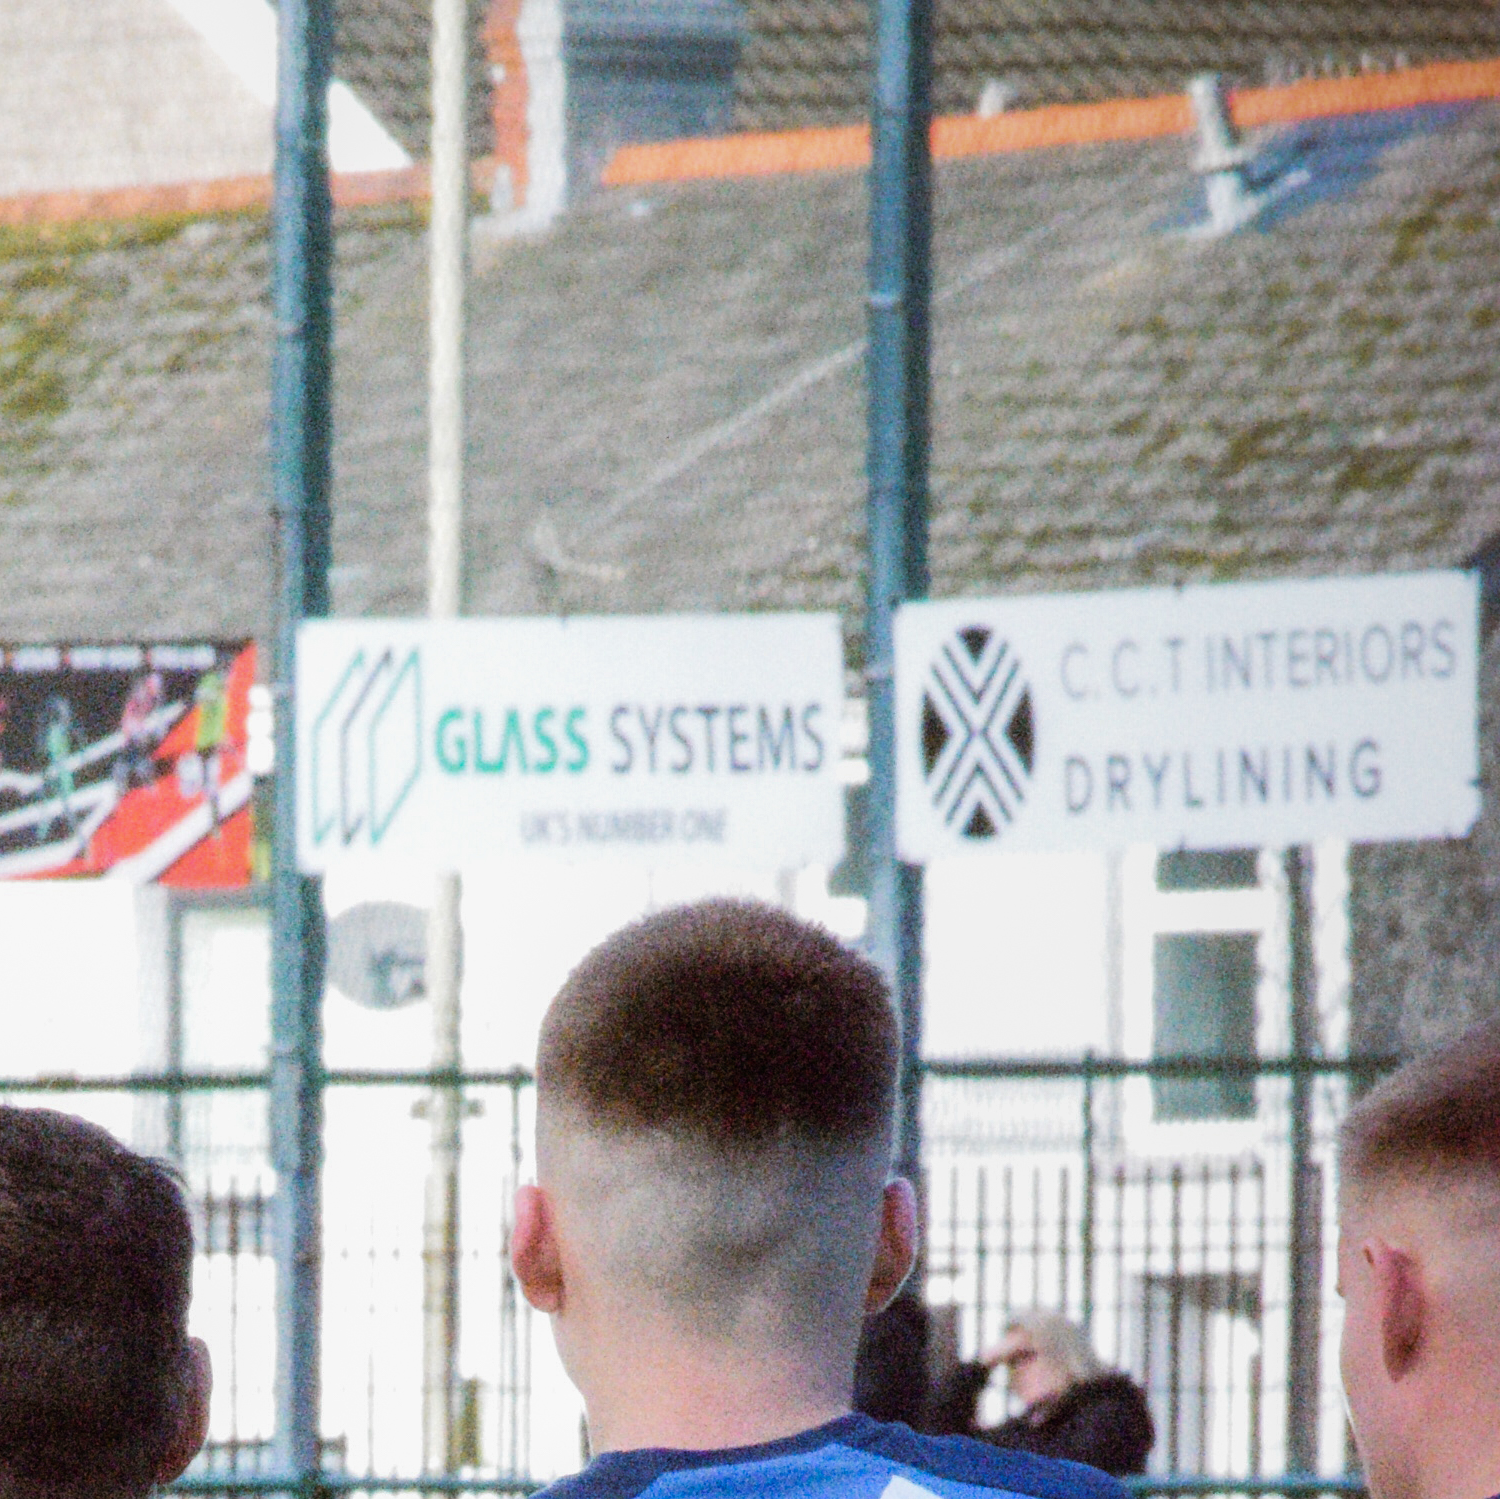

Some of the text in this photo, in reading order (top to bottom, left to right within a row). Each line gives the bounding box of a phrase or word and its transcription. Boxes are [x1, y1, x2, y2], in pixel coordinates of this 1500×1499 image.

[1204, 619, 1457, 696] INTERIORS
[434, 704, 825, 774] GLASS SYSTEMS
[1065, 739, 1383, 816] DRYLINING
